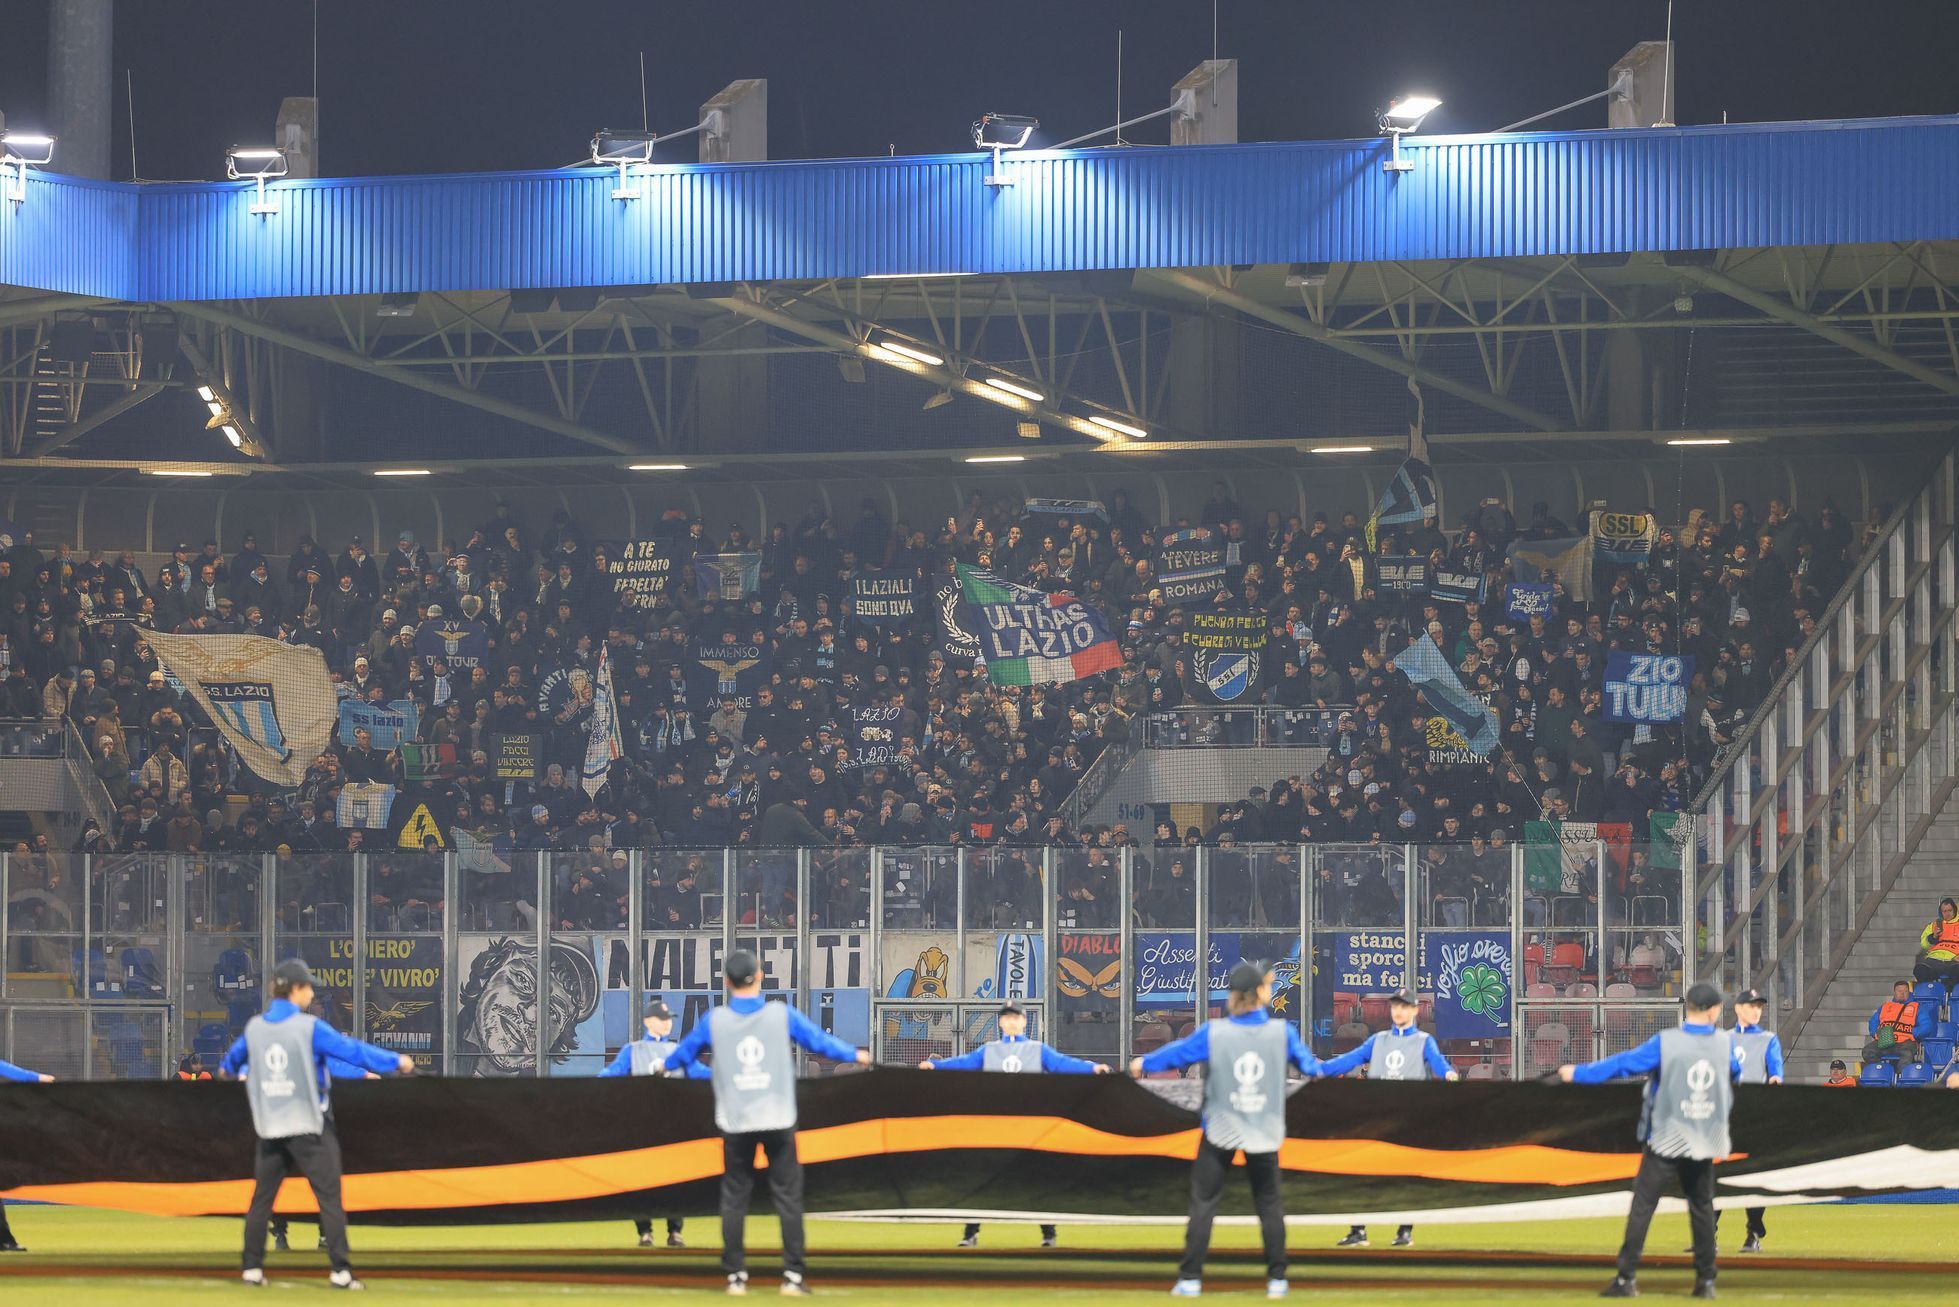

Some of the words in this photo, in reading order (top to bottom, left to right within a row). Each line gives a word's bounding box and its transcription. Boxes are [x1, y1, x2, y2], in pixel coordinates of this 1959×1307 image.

[624, 542, 634, 559] A
[639, 541, 655, 558] TE
[609, 561, 624, 574] HO
[626, 558, 670, 572] GIURATO
[1164, 551, 1219, 569] TEVERE
[613, 575, 669, 592] FEDELTA'
[862, 578, 913, 596] LAZIALI
[1165, 579, 1225, 598] ROMANA
[856, 600, 888, 616] SONO
[889, 599, 914, 617] QVA
[992, 620, 1094, 658] LAZIO
[700, 646, 759, 658] IMMENSO
[945, 641, 976, 657] curva
[445, 656, 479, 667] TOUR
[1627, 656, 1684, 684] ZIO
[225, 685, 270, 698] LAZIO
[538, 668, 568, 712] AVANTI
[706, 697, 752, 708] ARE
[1429, 750, 1490, 764] RIMPIAN
[329, 940, 416, 959] L'OIERO'
[1349, 932, 1426, 950] stanci
[1143, 939, 1223, 966] Asseti
[1348, 951, 1426, 969] sporci
[607, 935, 861, 991] MALEETTi
[380, 968, 440, 988] VIVRO'
[1136, 964, 1231, 1003] Giustifcat
[1342, 973, 1373, 987] ma
[1380, 970, 1433, 989] felci
